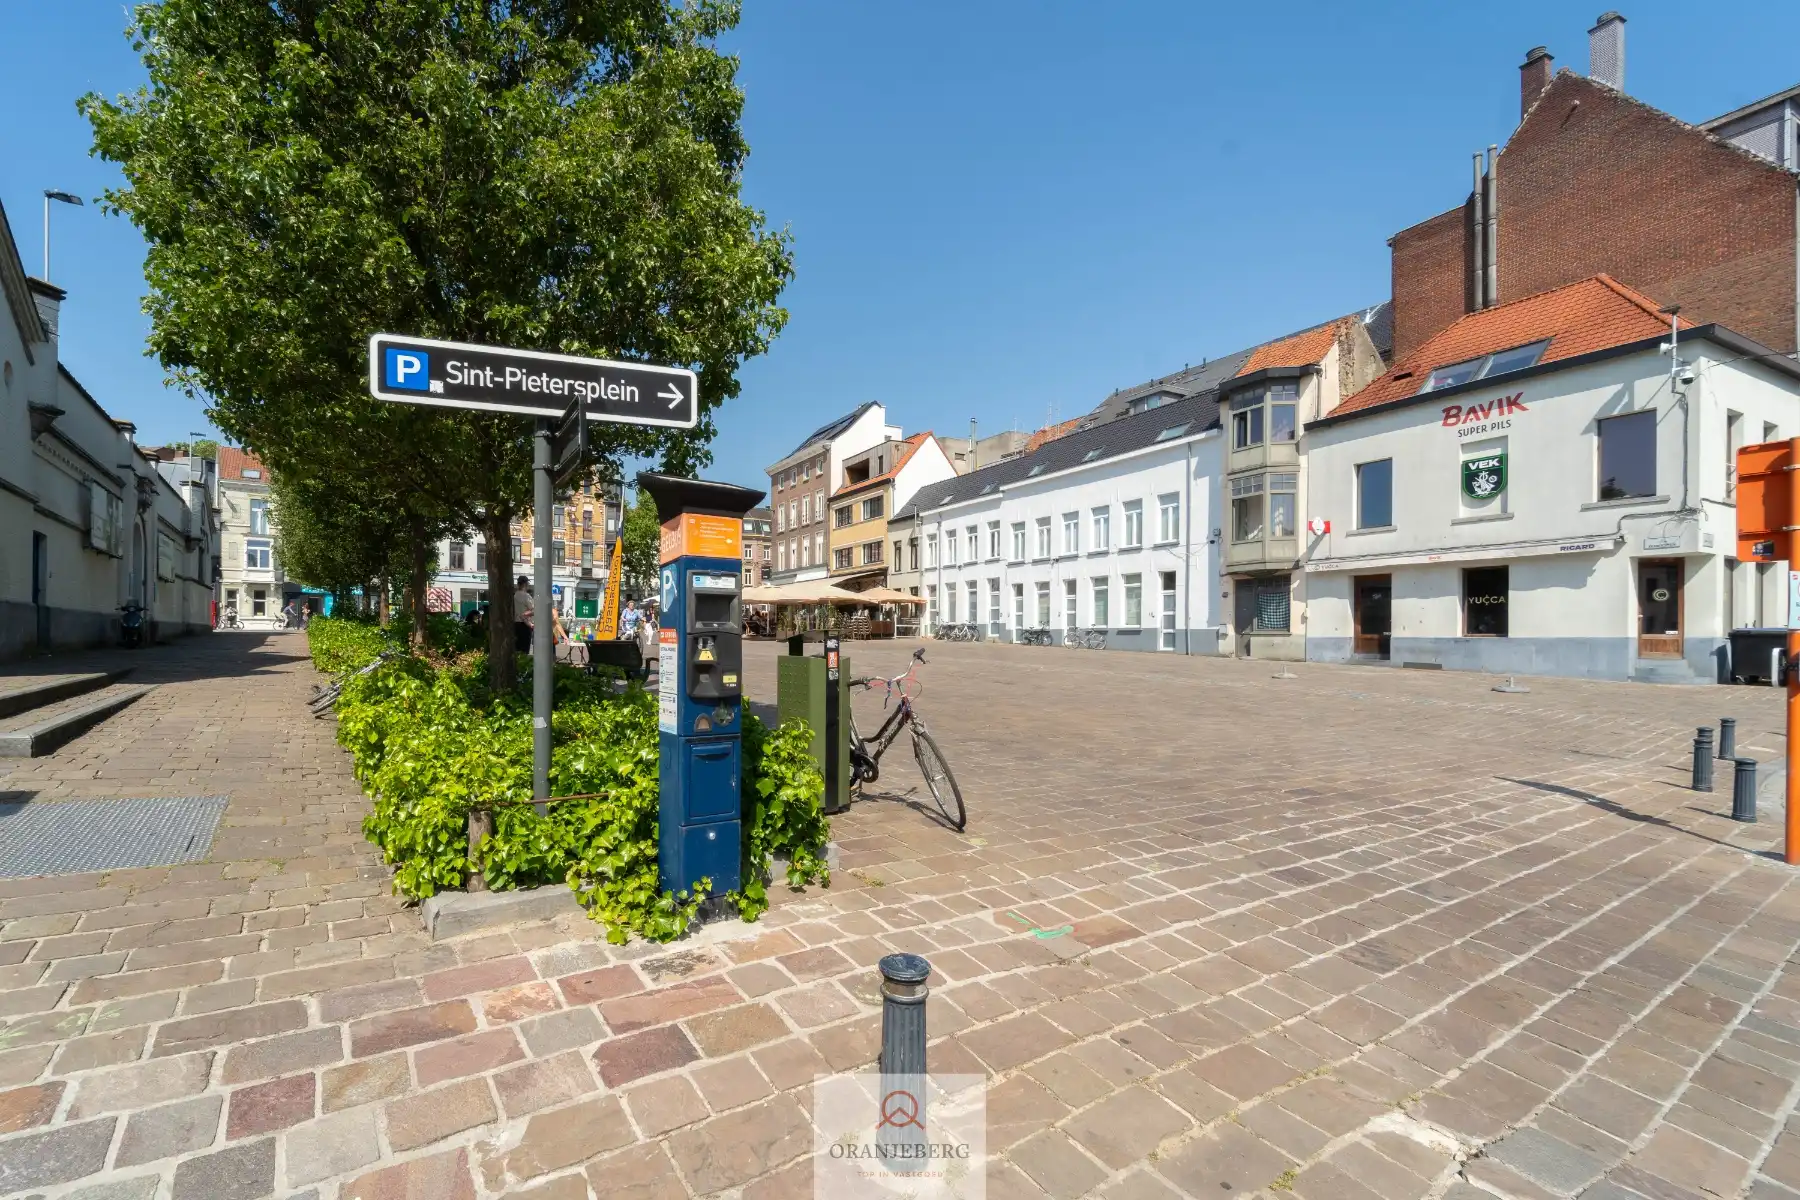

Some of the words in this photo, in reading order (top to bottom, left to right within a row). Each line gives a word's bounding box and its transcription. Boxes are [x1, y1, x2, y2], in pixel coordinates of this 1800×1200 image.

[396, 355, 421, 383] P
[446, 361, 639, 403] Sint-Pietersplein
[1441, 391, 1530, 427] BAVIK
[1458, 424, 1488, 438] SUPER
[1490, 419, 1512, 432] PILS
[1468, 457, 1500, 470] VEK
[1560, 543, 1595, 551] RICARD
